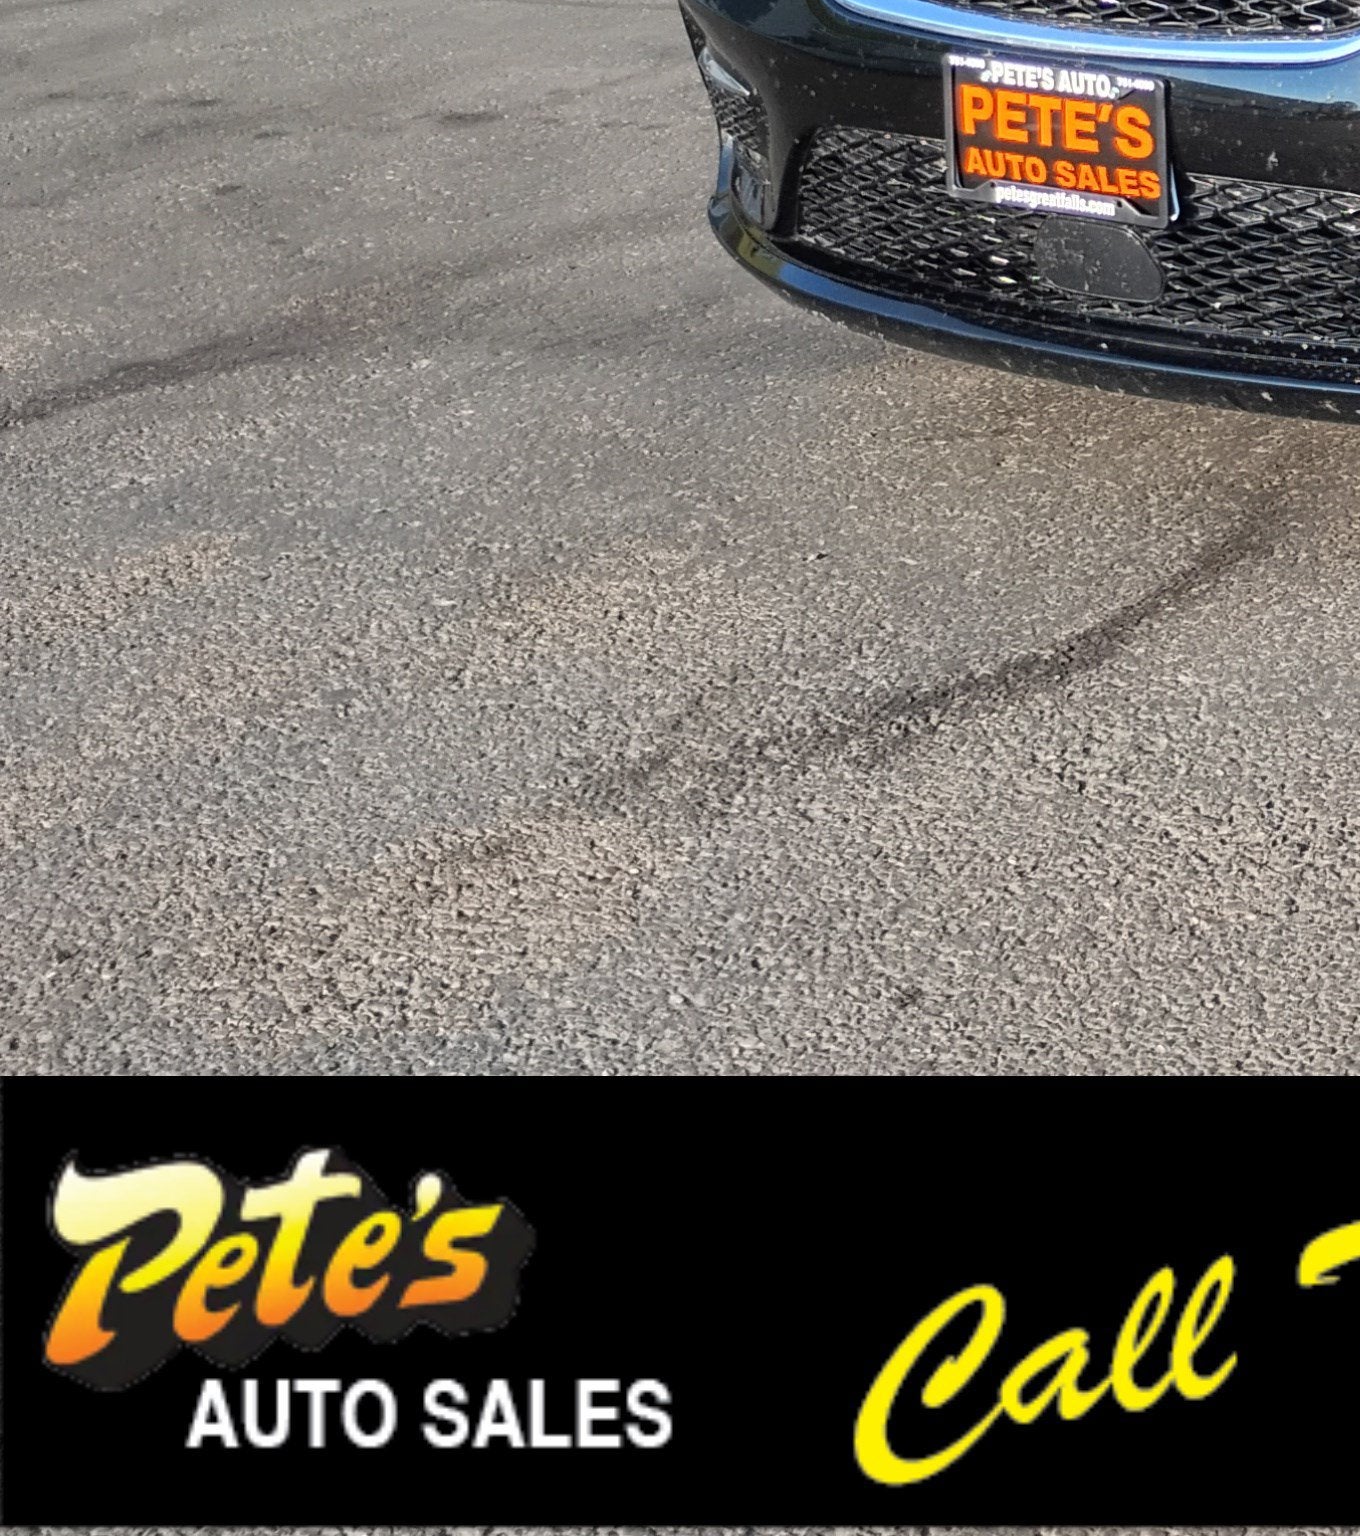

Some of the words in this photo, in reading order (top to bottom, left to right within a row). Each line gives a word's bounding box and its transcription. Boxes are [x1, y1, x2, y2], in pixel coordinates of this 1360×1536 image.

[1060, 69, 1112, 98] AUTO
[959, 83, 1154, 160] PETE'S
[965, 147, 1047, 184] AUTO
[1055, 160, 1161, 199] SALES
